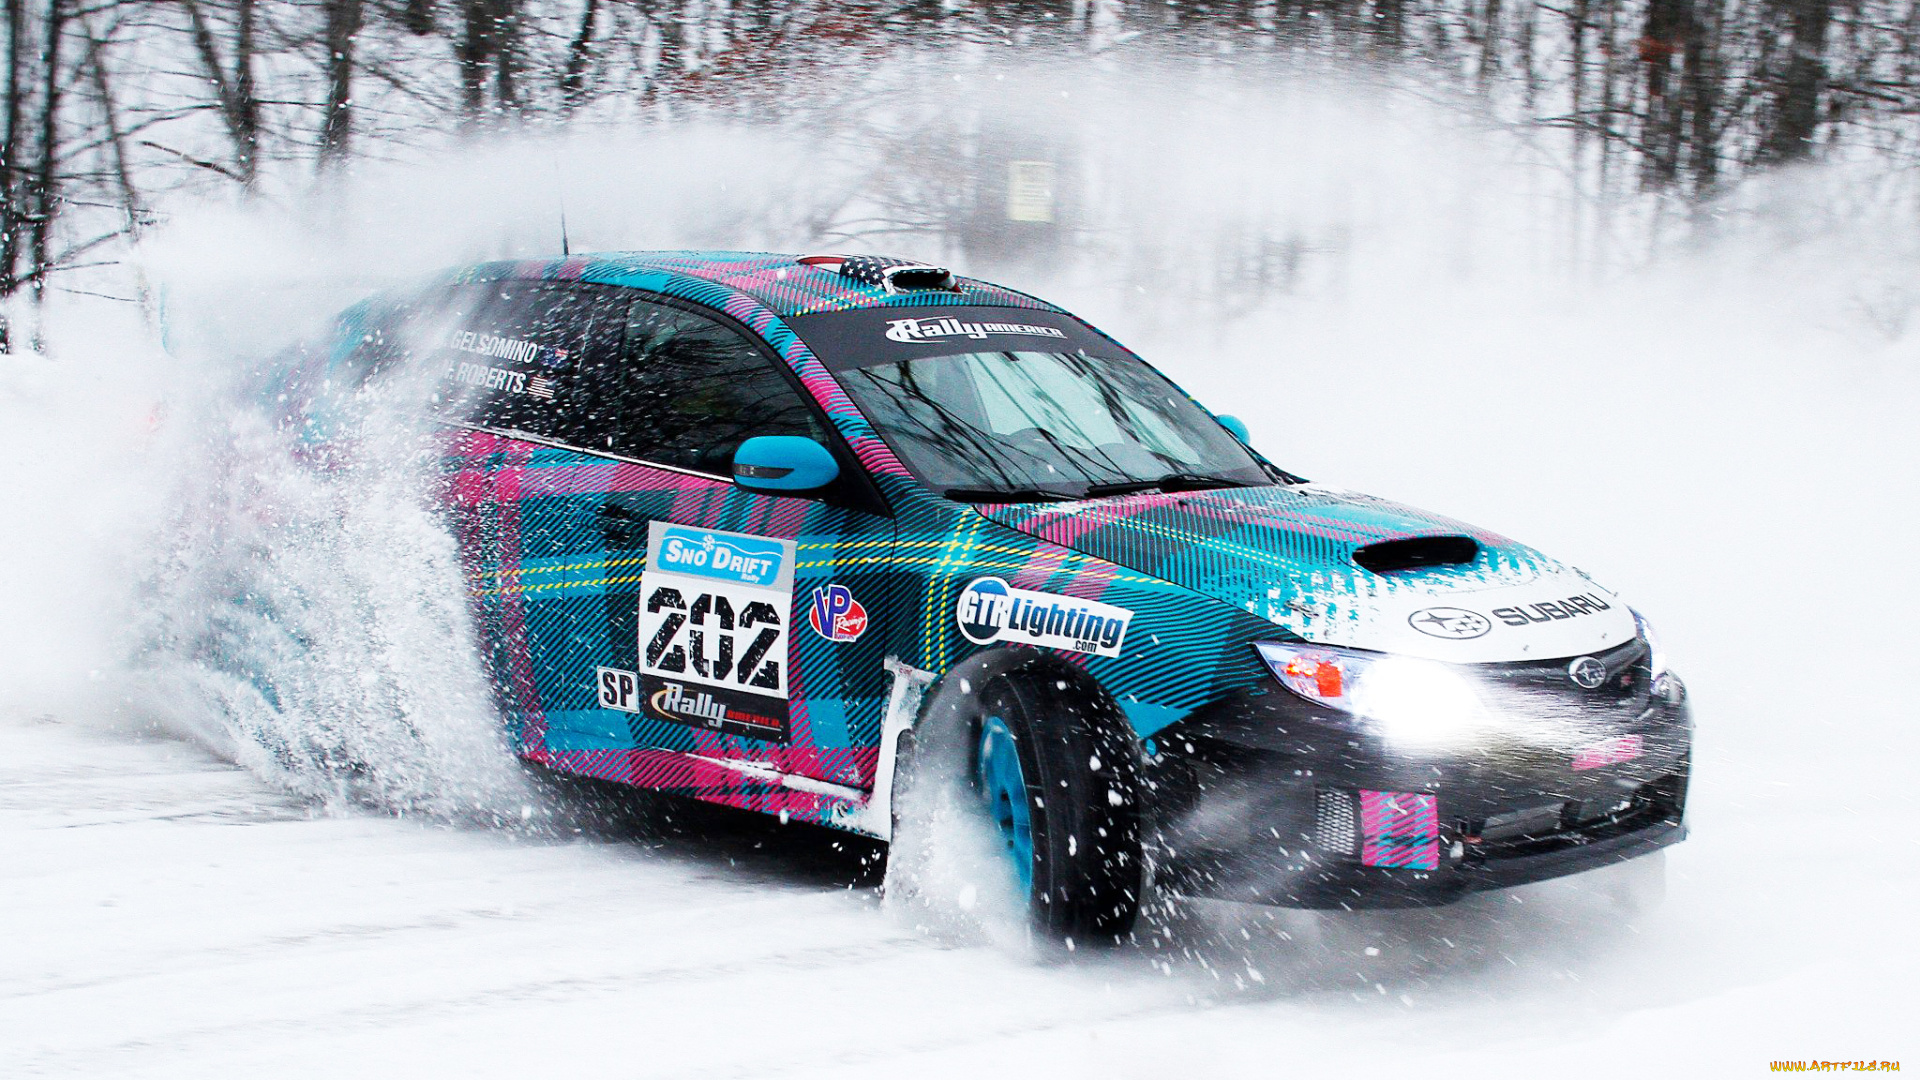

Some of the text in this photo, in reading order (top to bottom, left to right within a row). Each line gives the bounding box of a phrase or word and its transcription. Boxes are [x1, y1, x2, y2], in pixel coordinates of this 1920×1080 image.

[451, 329, 538, 364] GELSOMINO
[886, 316, 988, 343] Rally
[456, 361, 527, 394] ROBERTS
[812, 584, 853, 640] VP
[1008, 597, 1125, 649] Lighting
[1491, 592, 1611, 627] SUBARU
[646, 586, 782, 691] 202
[602, 671, 634, 708] SP
[661, 681, 727, 729] Rally
